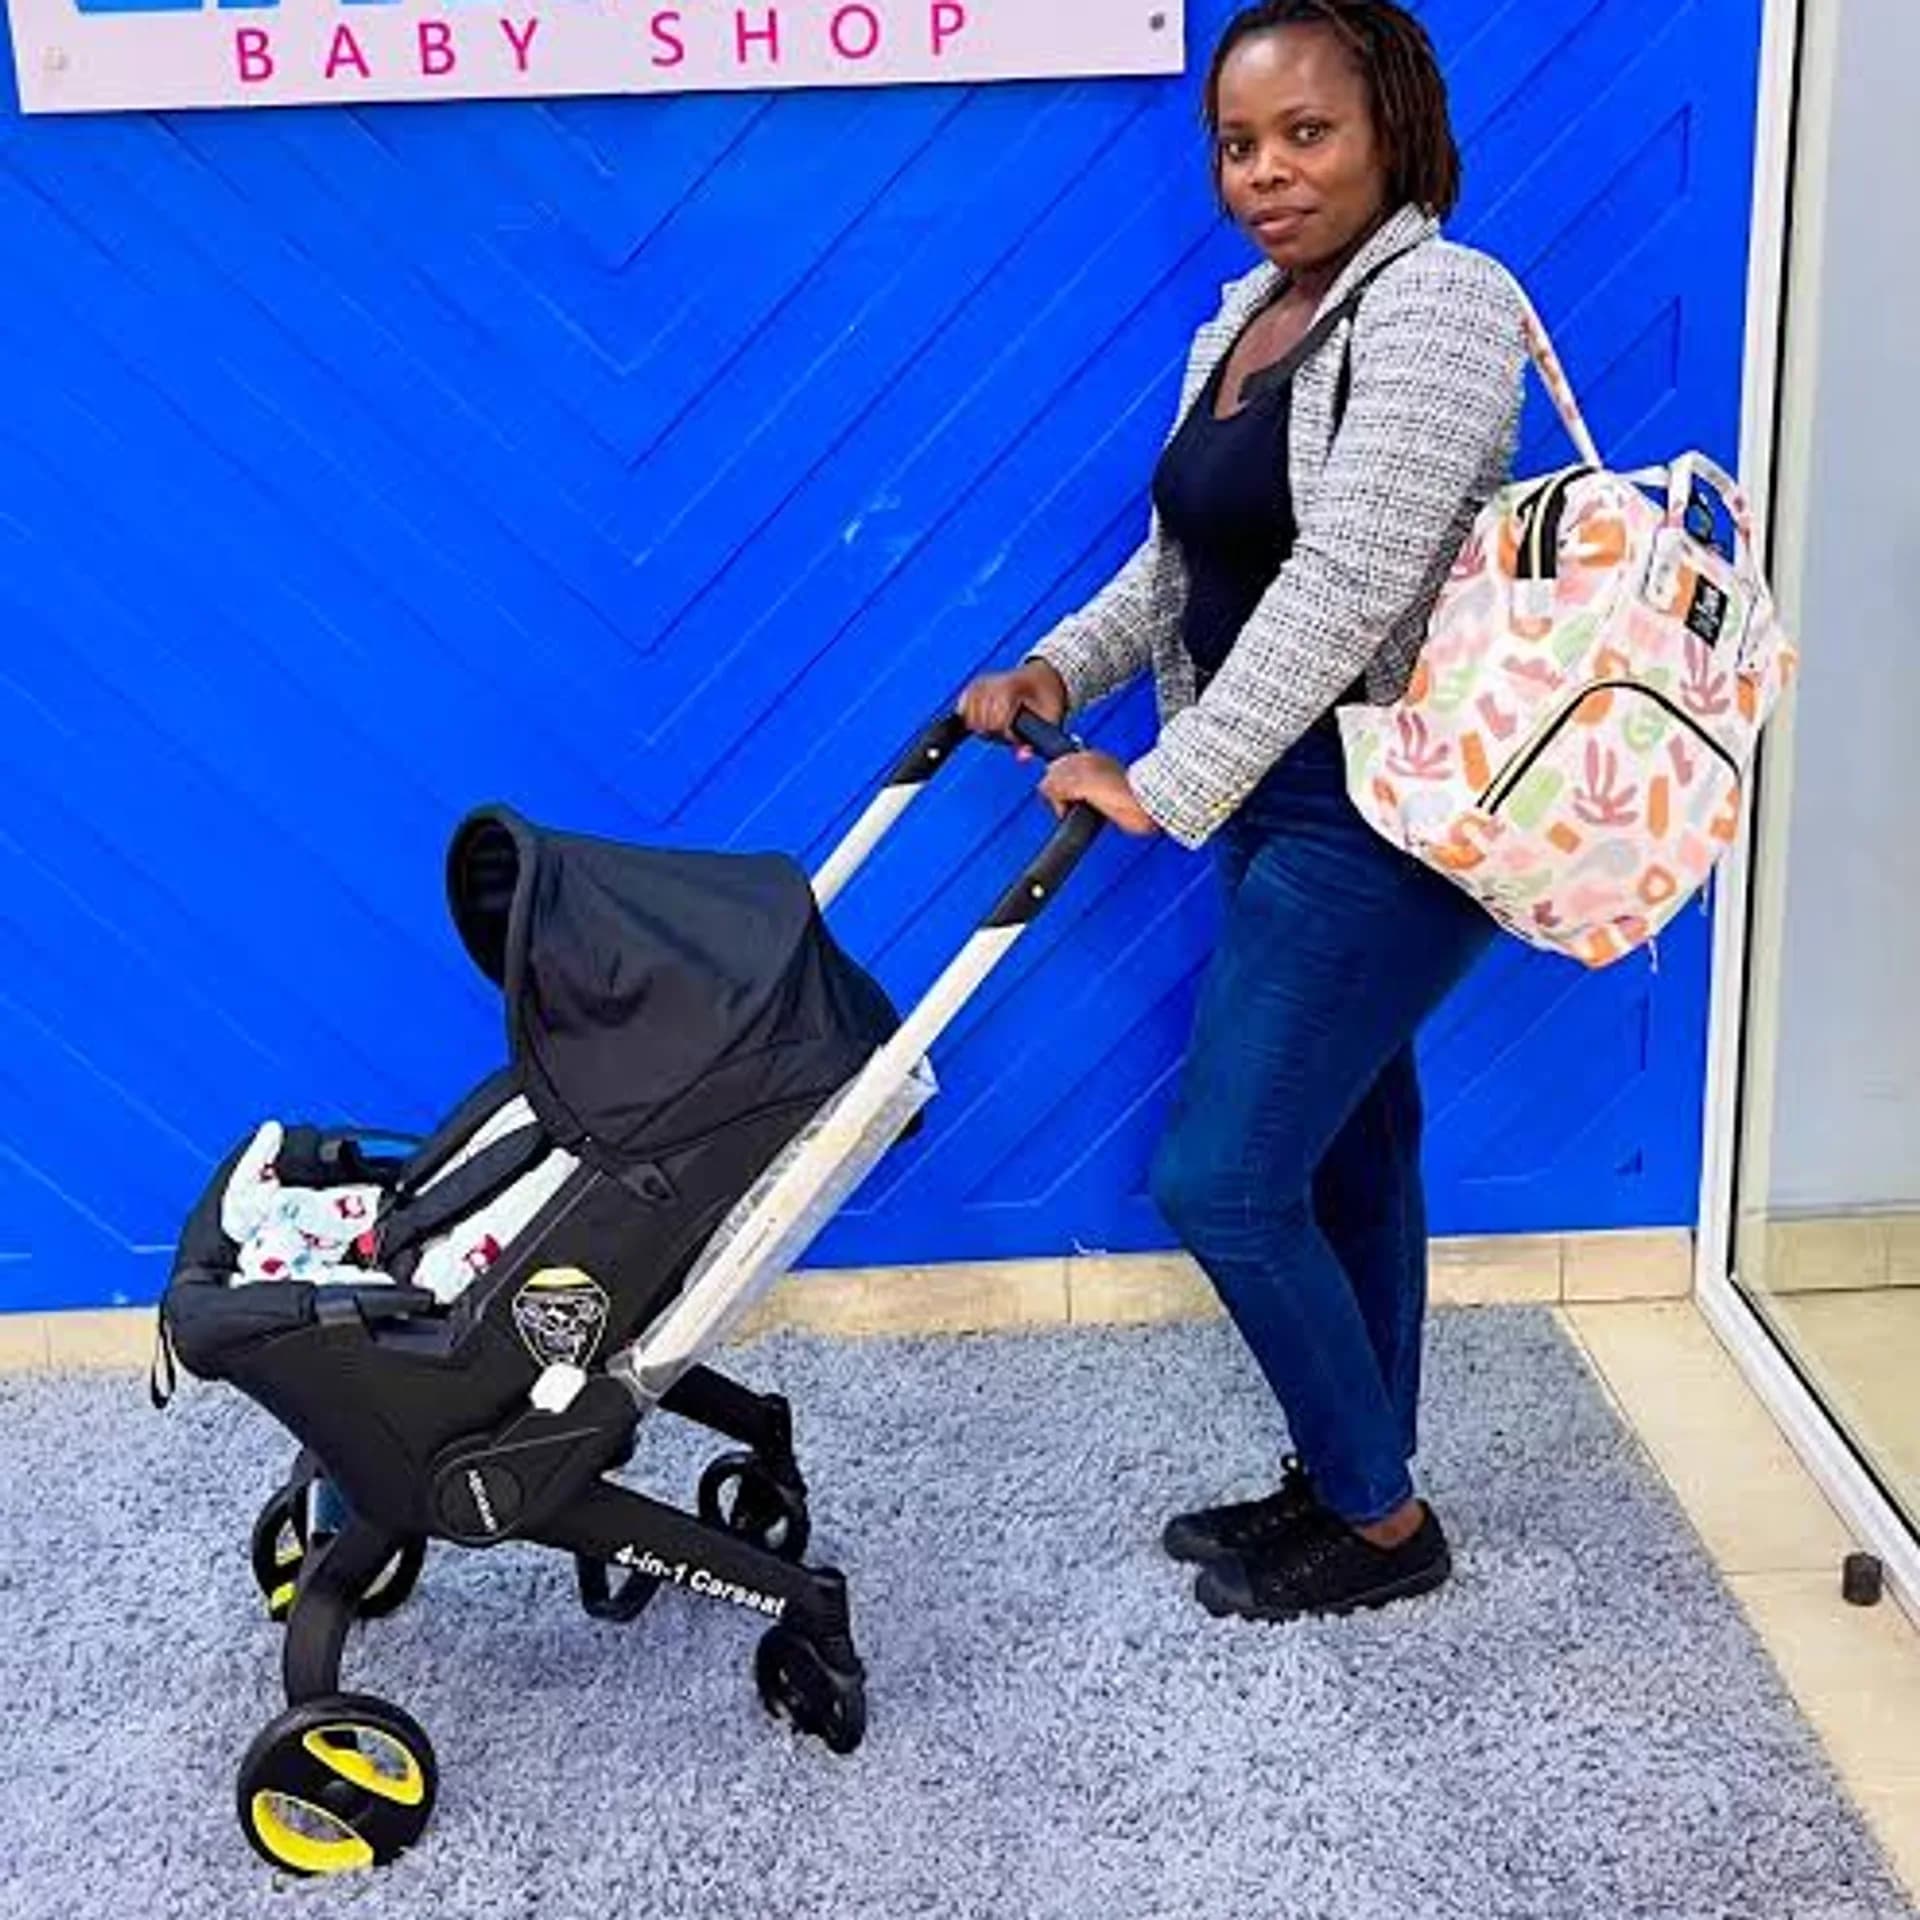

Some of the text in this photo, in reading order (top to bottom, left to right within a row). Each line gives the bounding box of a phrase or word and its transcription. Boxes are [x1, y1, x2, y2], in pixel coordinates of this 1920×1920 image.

[234, 0, 969, 84] BABY SHOP
[614, 1543, 689, 1585] 4-in-1
